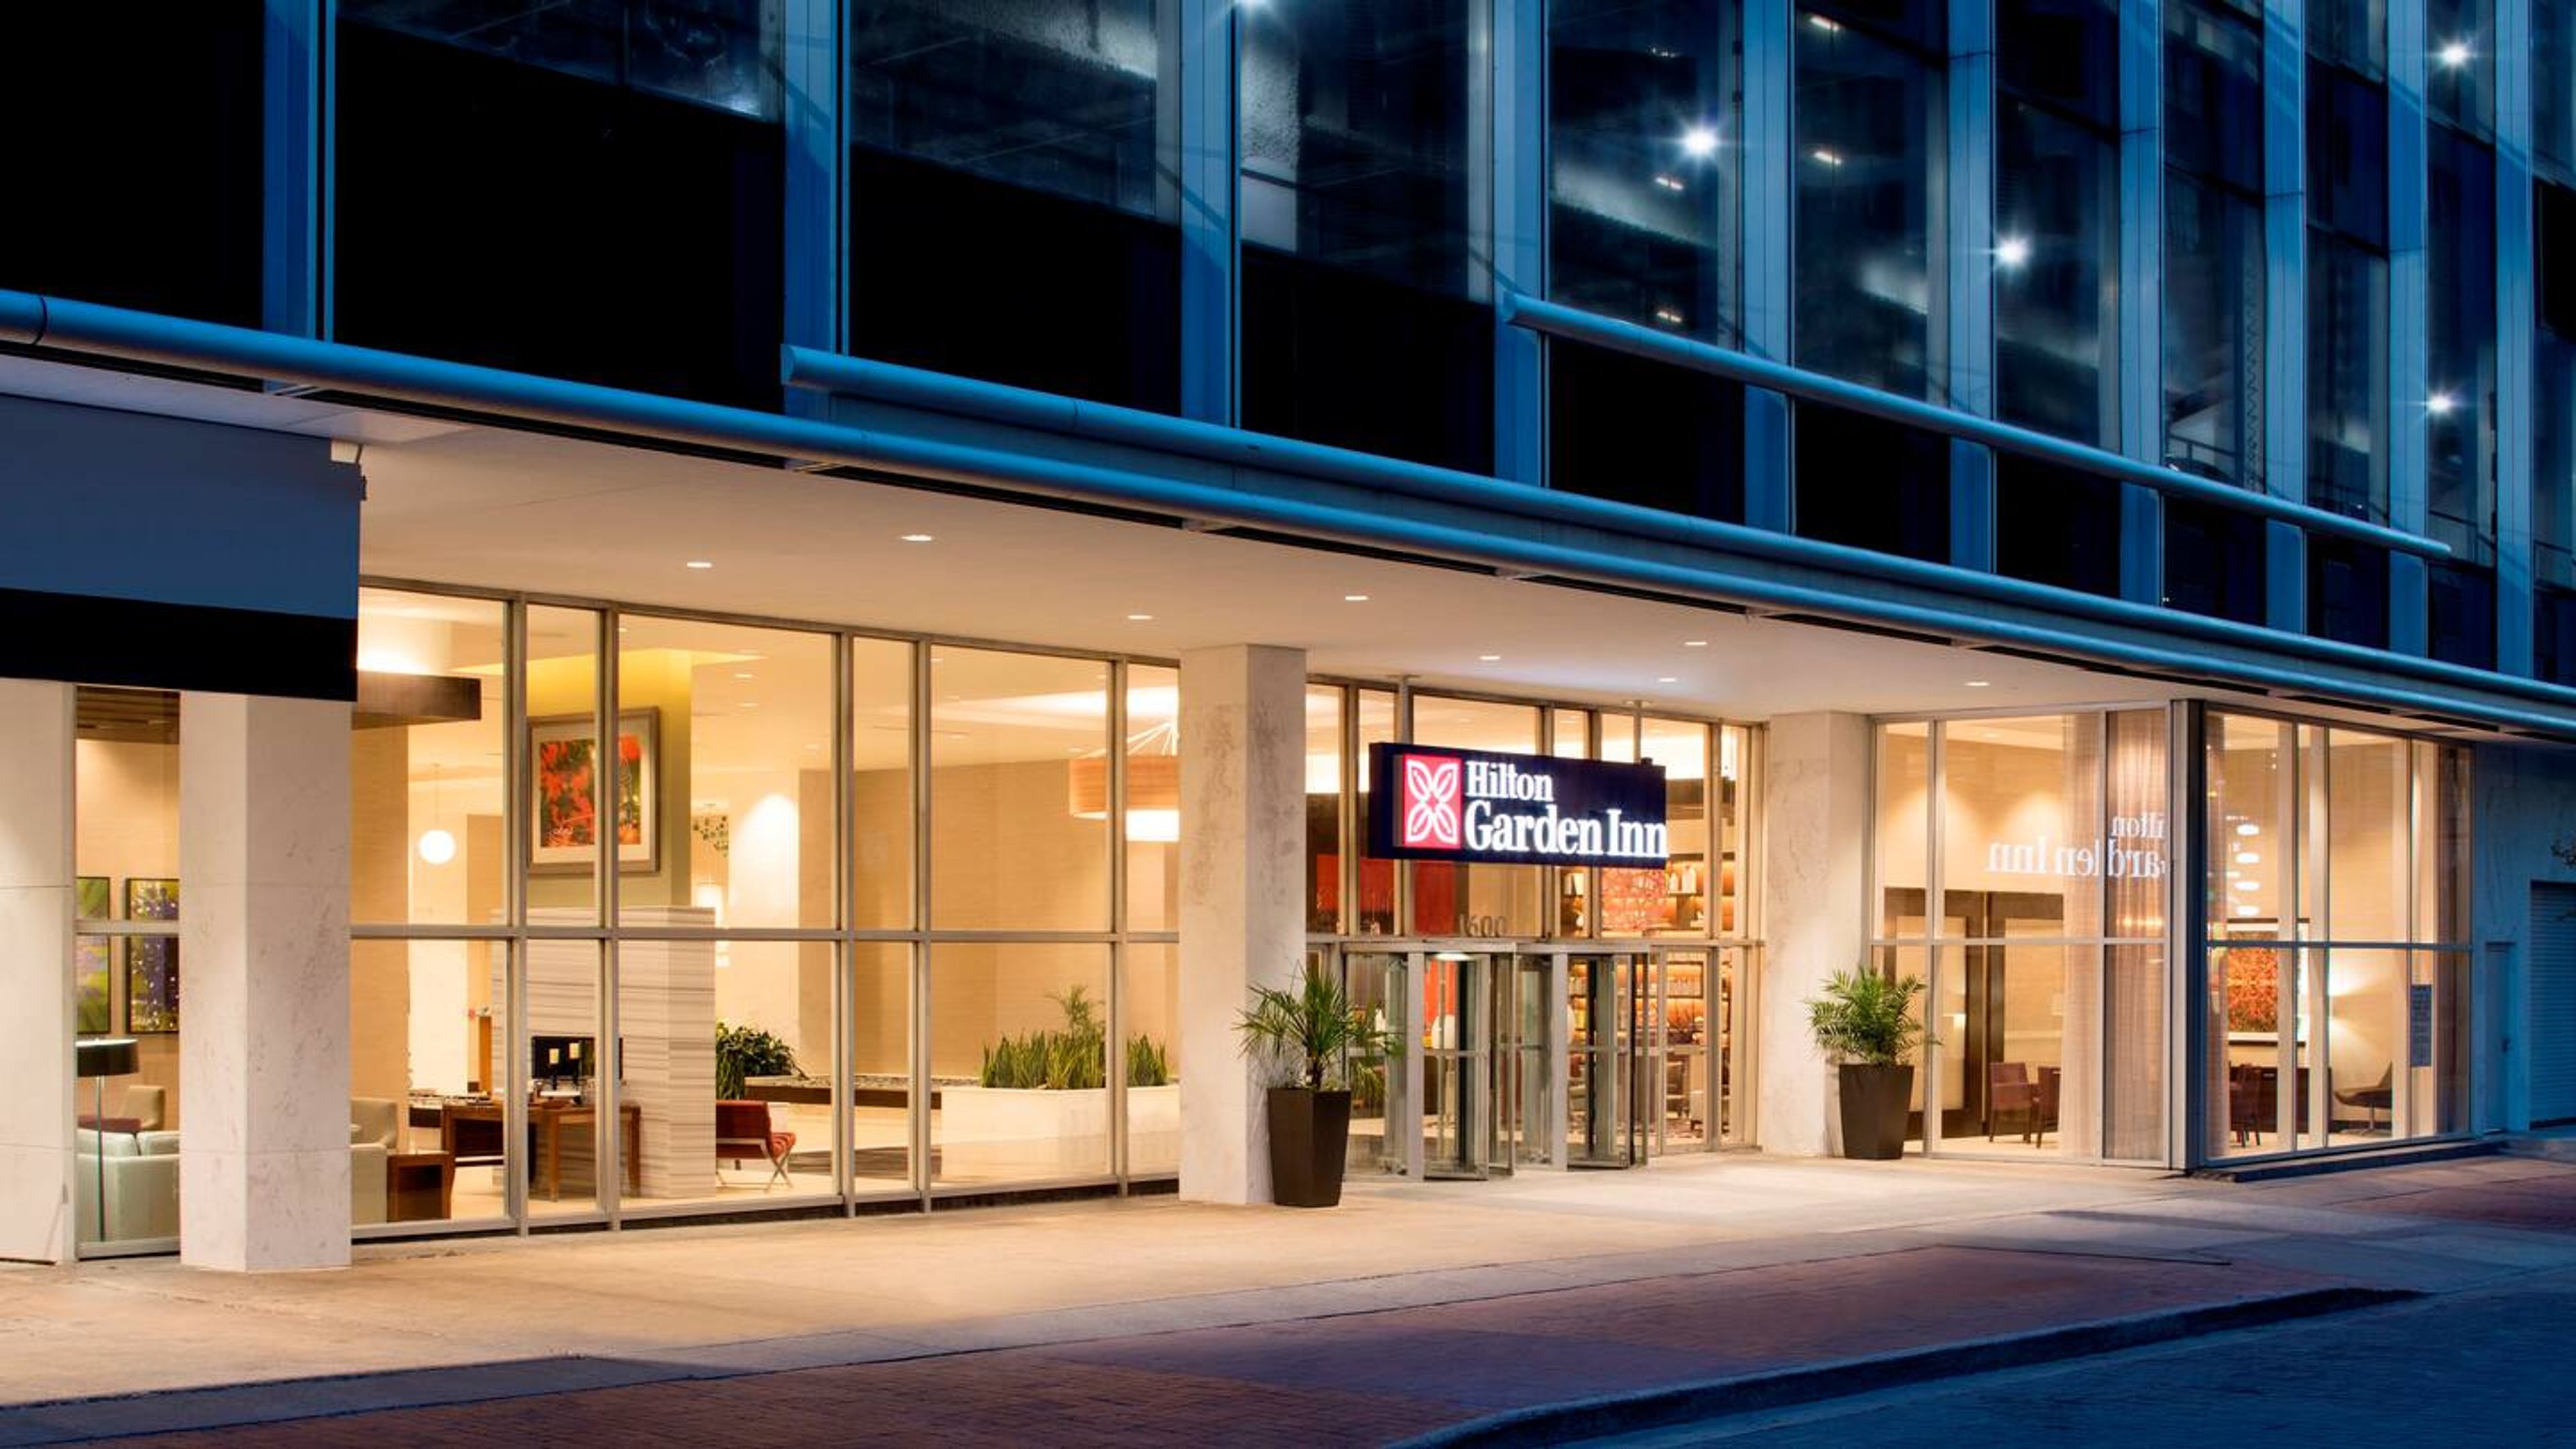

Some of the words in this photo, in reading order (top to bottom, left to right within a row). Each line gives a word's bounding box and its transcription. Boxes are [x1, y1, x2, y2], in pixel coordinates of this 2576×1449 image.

[1465, 761, 1554, 802] Hilton
[1465, 800, 1603, 855] Garden
[1606, 808, 1669, 857] Inn
